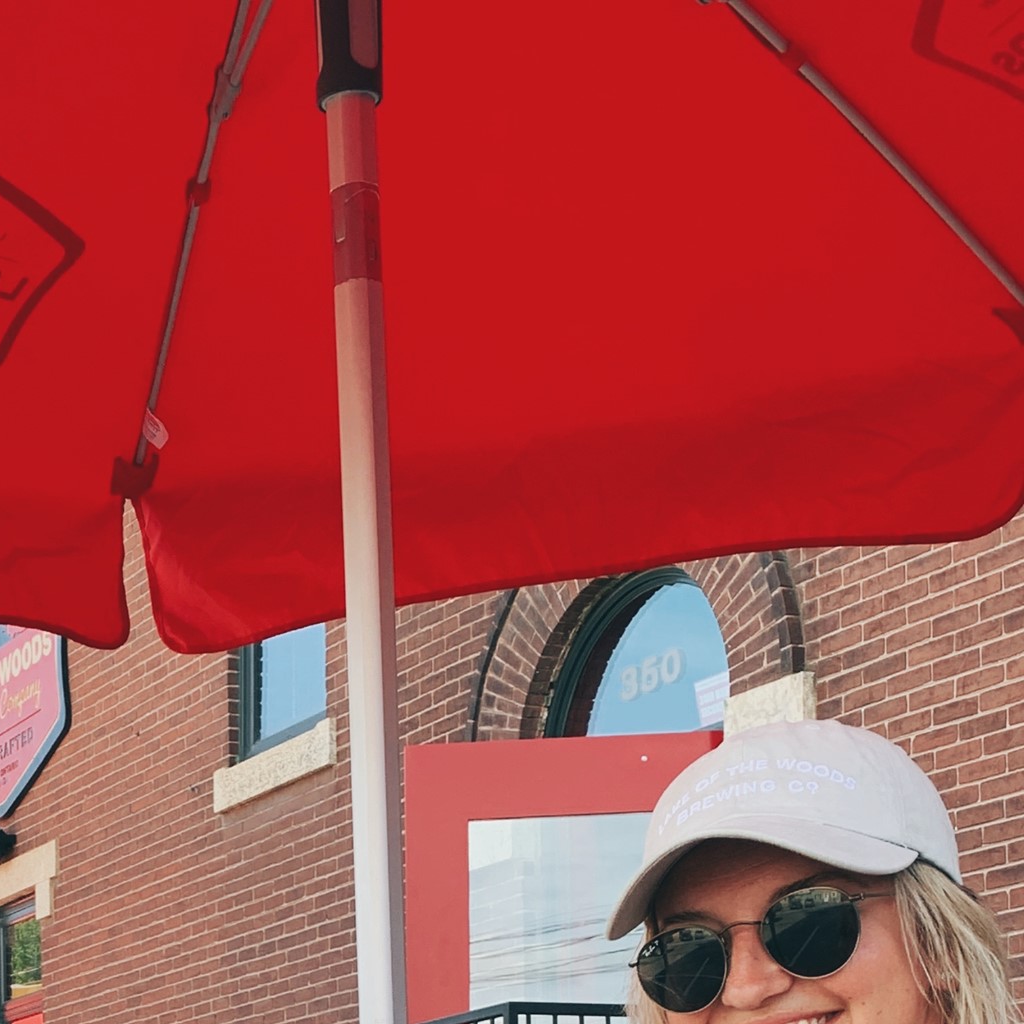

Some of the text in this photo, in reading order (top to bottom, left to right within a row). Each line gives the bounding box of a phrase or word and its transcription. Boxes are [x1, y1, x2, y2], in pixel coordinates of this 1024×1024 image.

[694, 771, 721, 793] OF
[726, 758, 769, 778] THE
[776, 757, 857, 791] WOODS
[676, 779, 777, 827] BREWING
